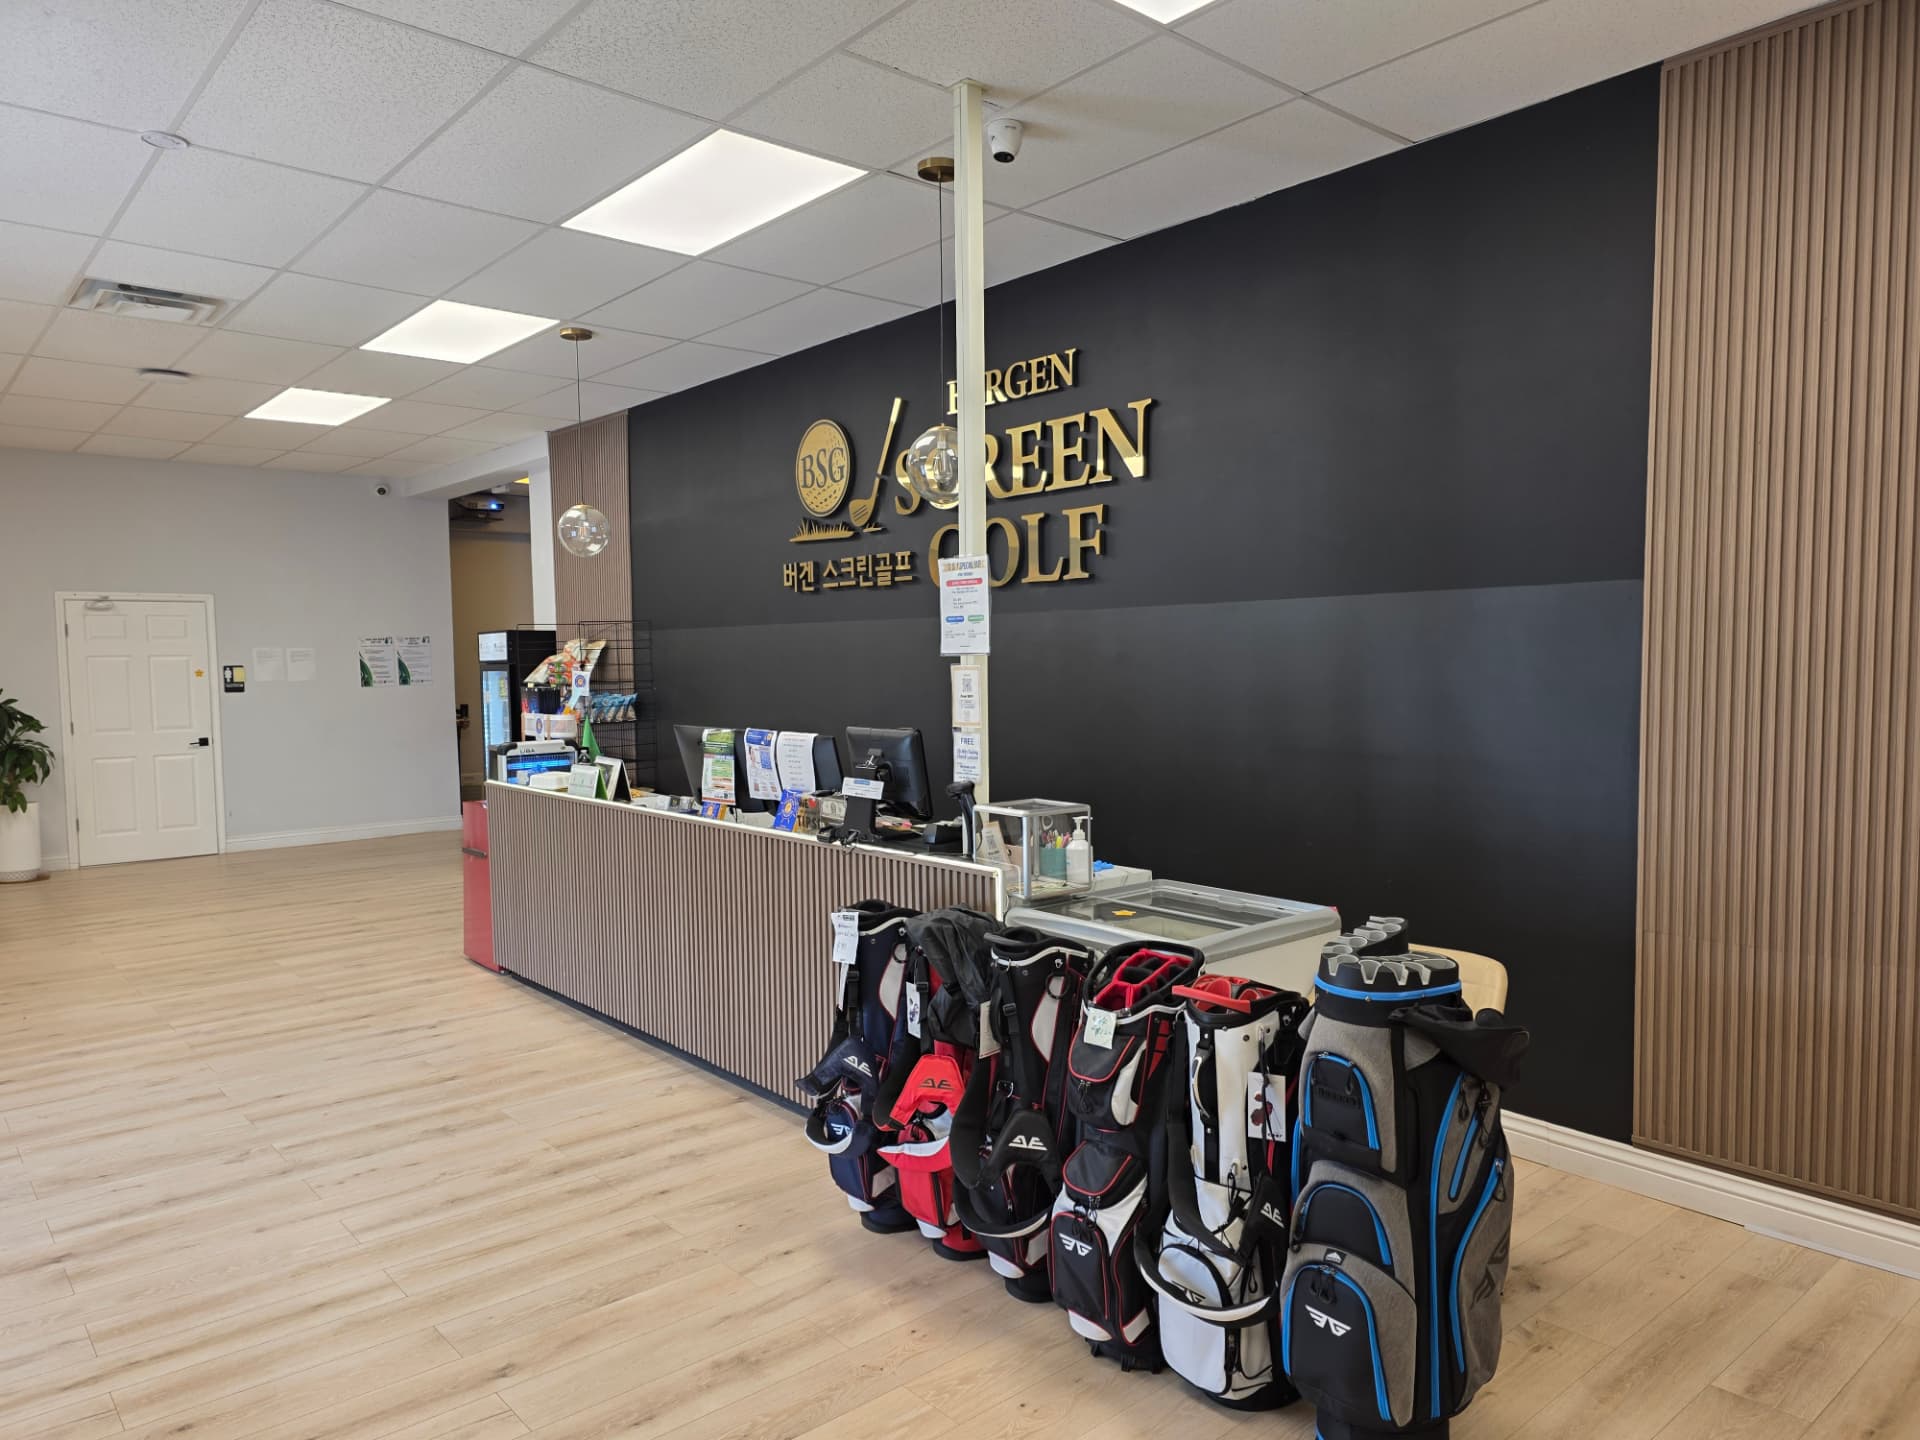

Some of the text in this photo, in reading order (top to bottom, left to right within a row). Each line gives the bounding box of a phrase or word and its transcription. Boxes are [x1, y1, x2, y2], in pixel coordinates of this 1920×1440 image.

[801, 447, 845, 489] BSG
[783, 550, 913, 593] 버겐 스크린골프
[960, 737, 975, 746] FREE
